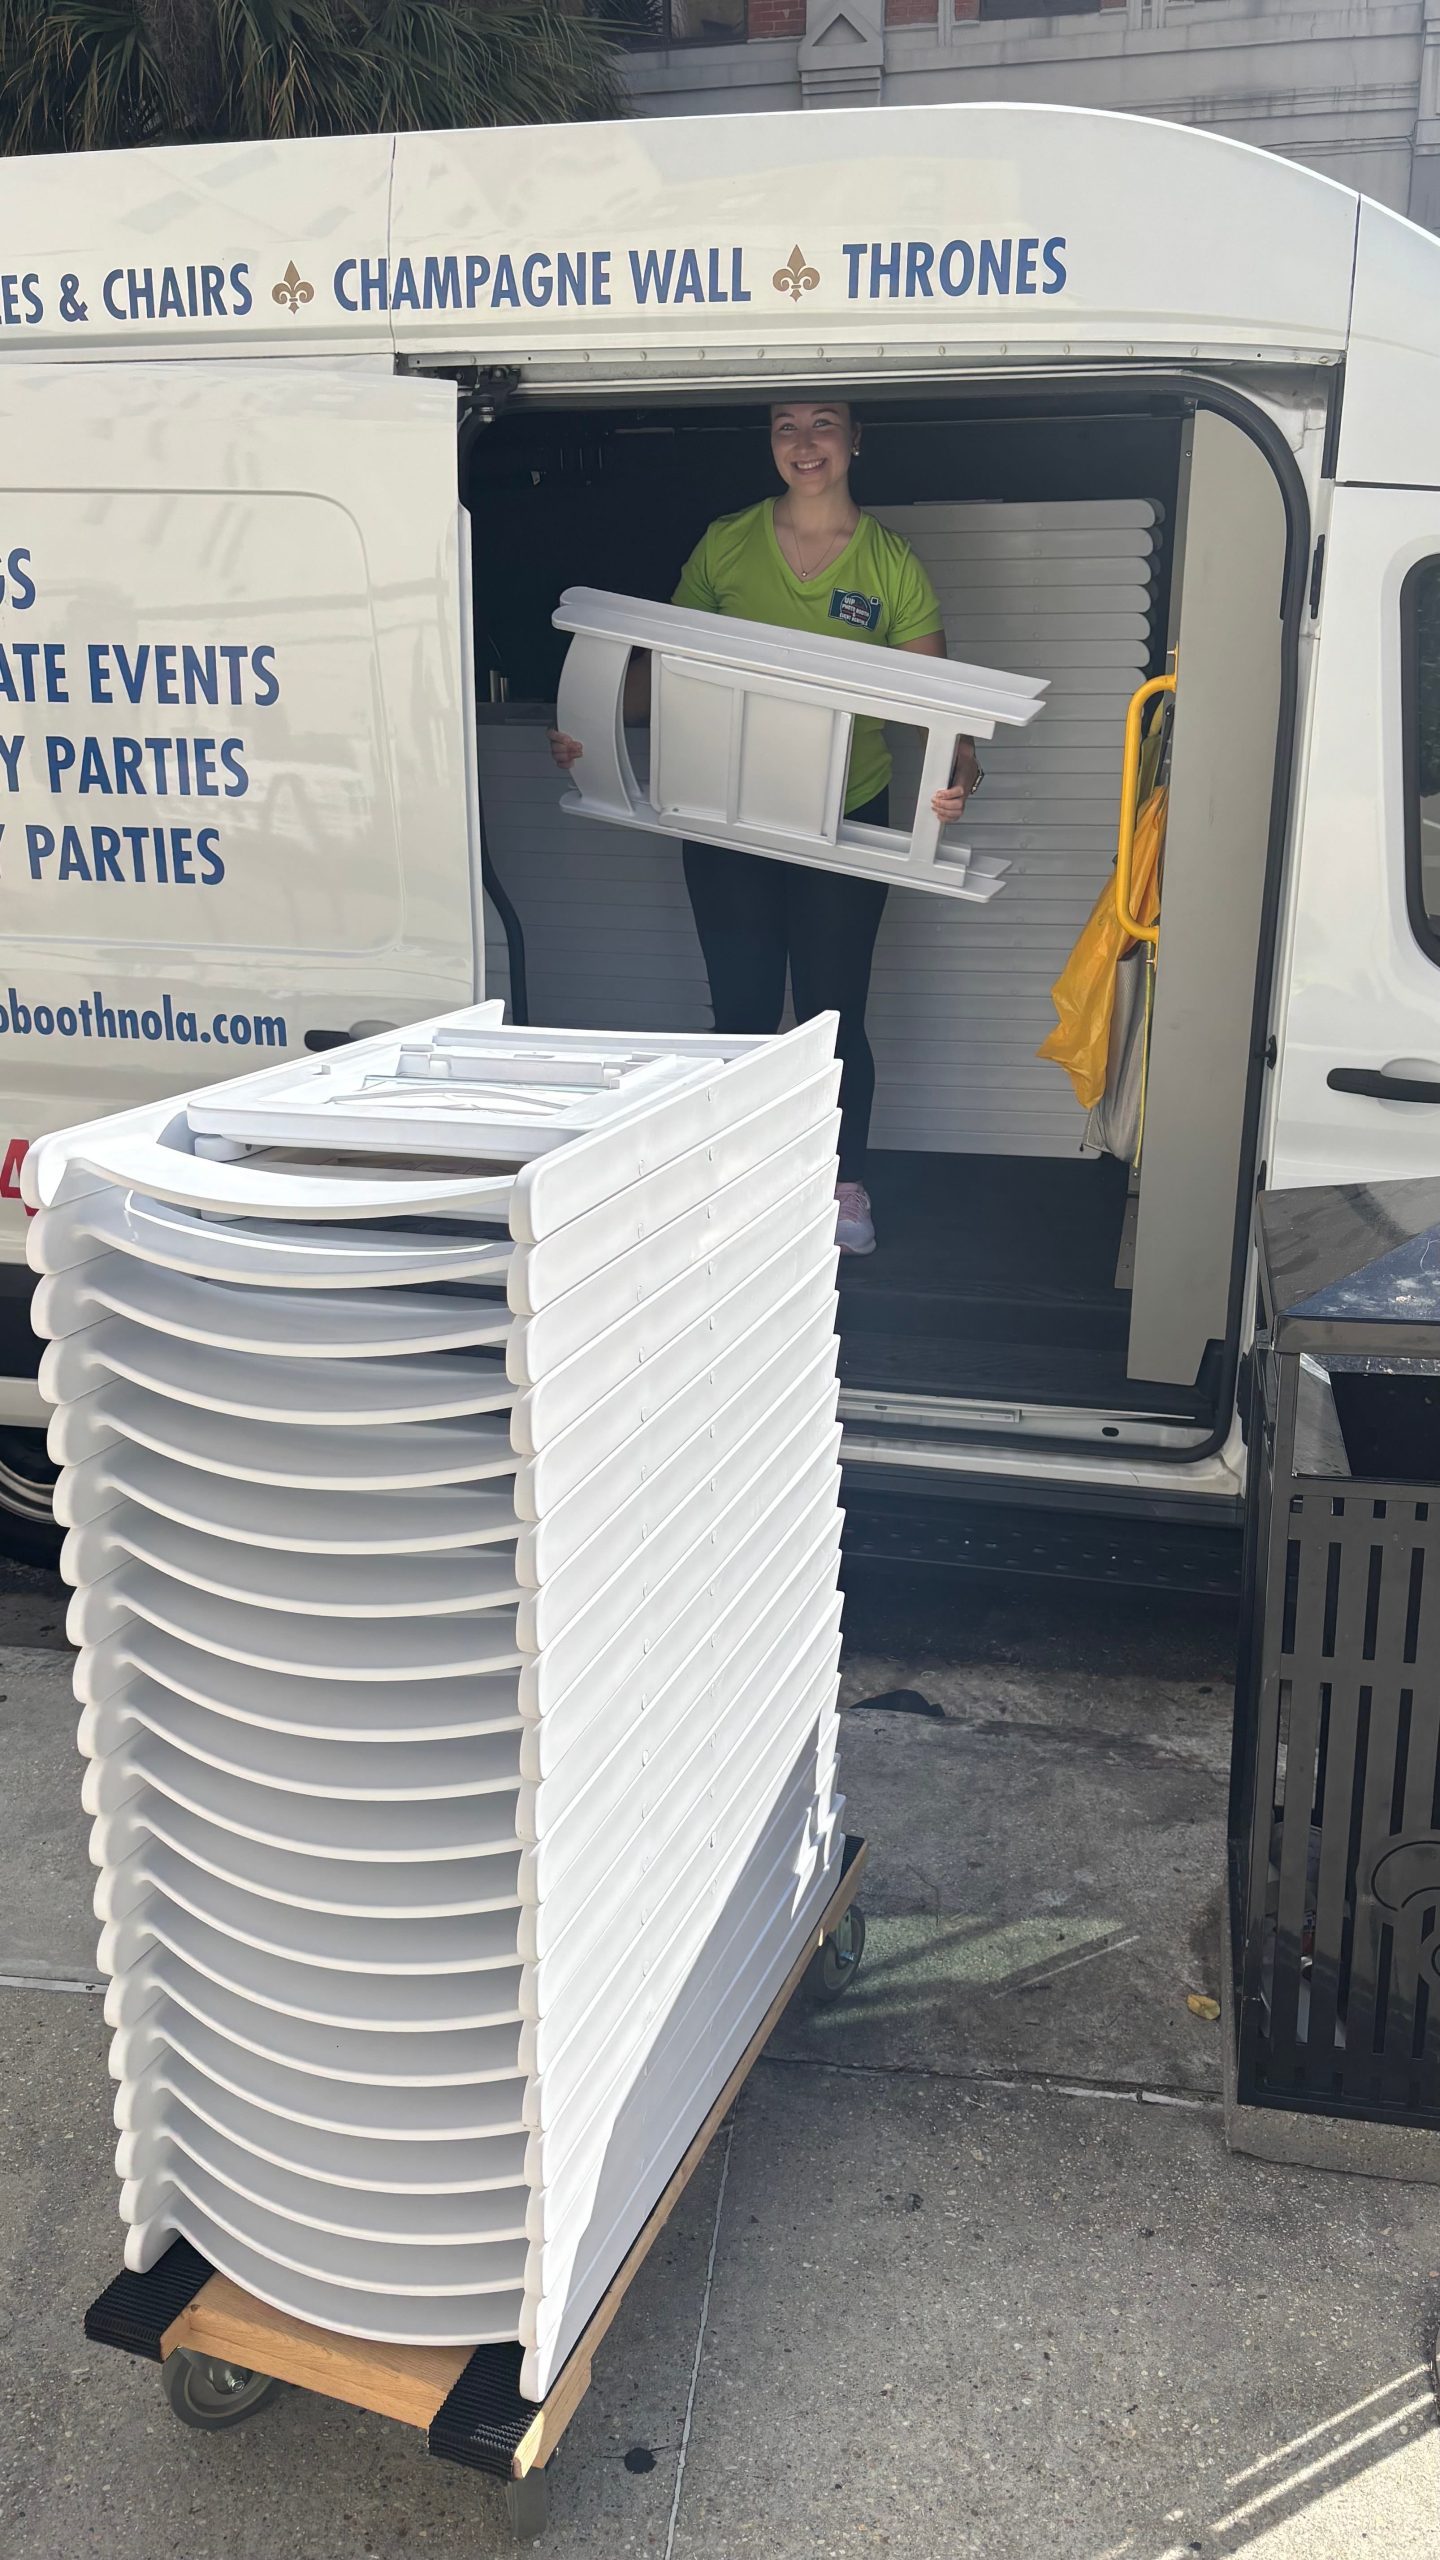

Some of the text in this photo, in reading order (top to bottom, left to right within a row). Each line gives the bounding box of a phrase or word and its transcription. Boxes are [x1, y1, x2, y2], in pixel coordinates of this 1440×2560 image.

[59, 273, 89, 323] &
[103, 263, 253, 320] CHAIRS
[333, 252, 611, 312] CHAMPAGNE
[628, 247, 751, 304] WALL
[842, 235, 1068, 299] THRONES
[87, 643, 280, 707] EVENTS
[45, 735, 250, 799] PARTIES
[25, 824, 226, 886] PARTIES
